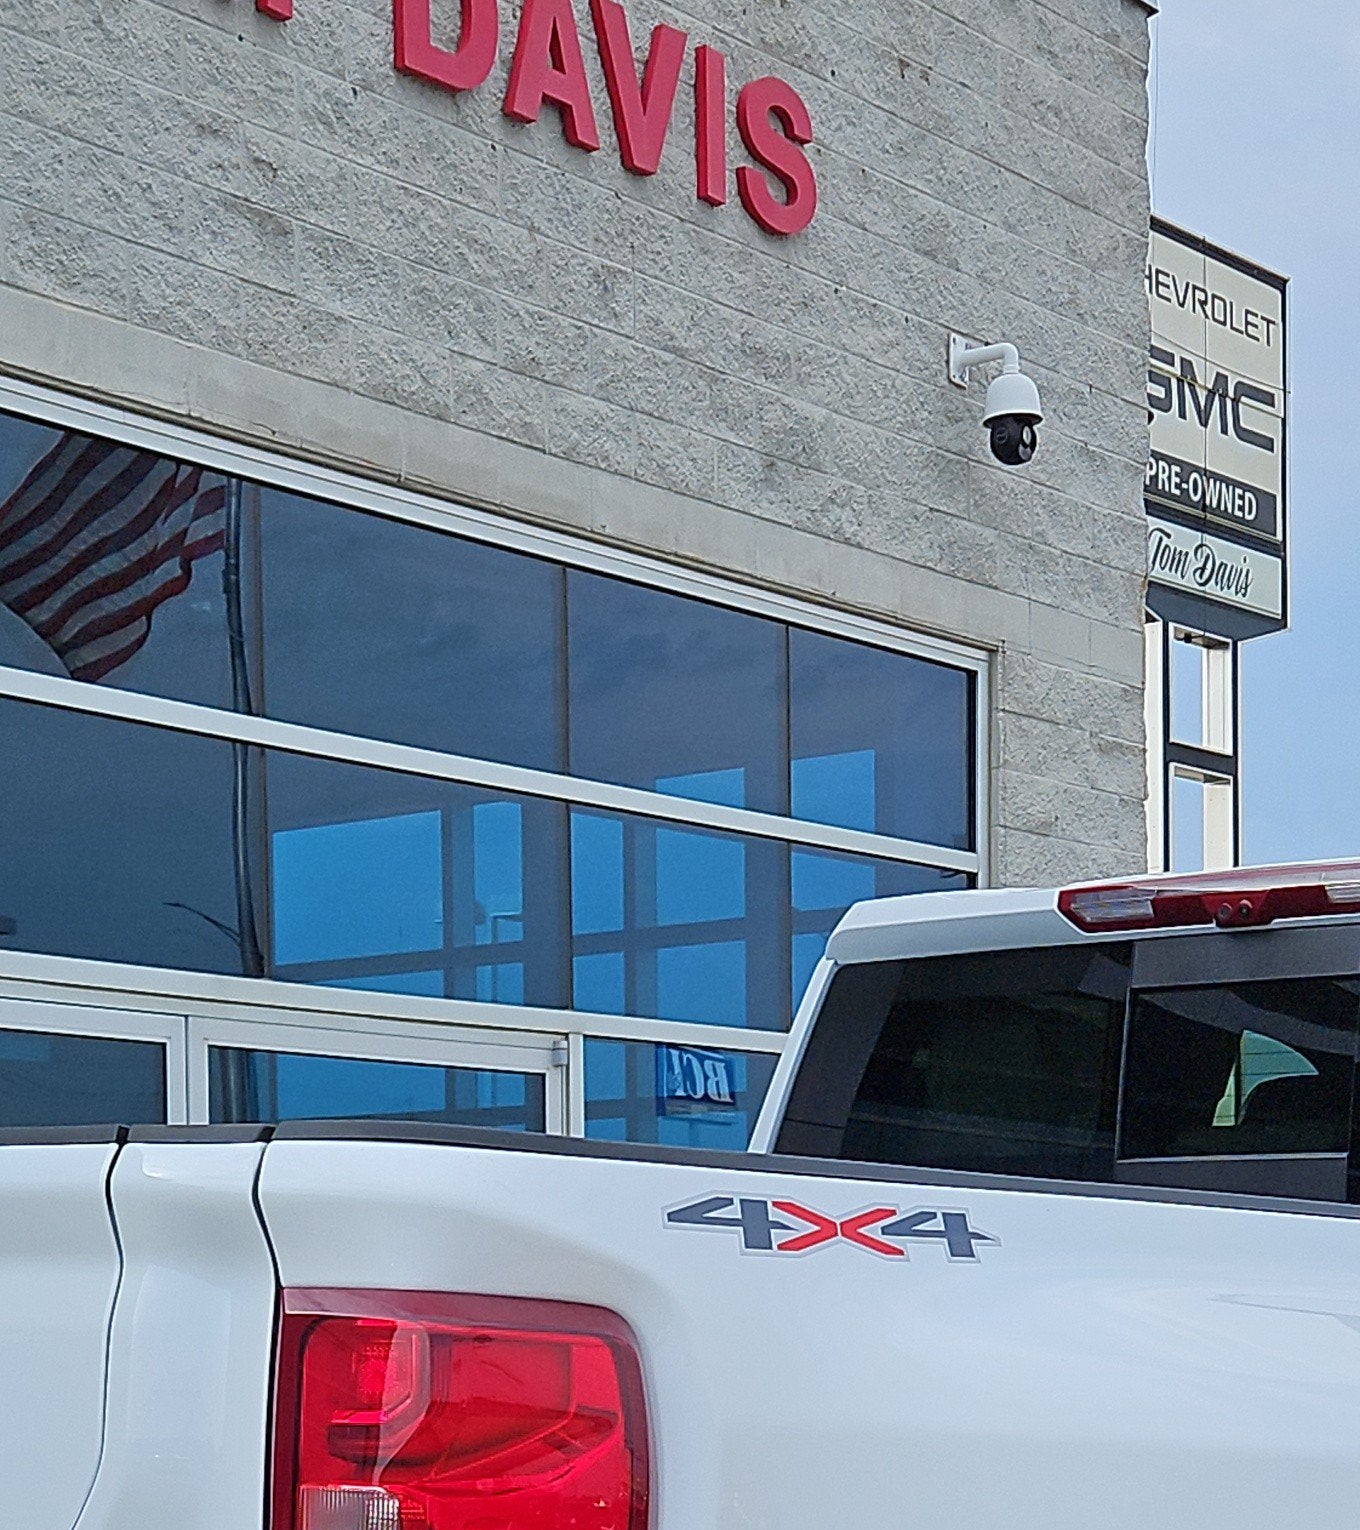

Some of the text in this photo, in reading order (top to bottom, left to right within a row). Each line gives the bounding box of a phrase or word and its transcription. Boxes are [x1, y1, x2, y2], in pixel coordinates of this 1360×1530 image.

[1144, 263, 1277, 348] HEVROLET
[1144, 456, 1258, 521] PRE-OWNED
[1148, 527, 1254, 598] Tom Davis
